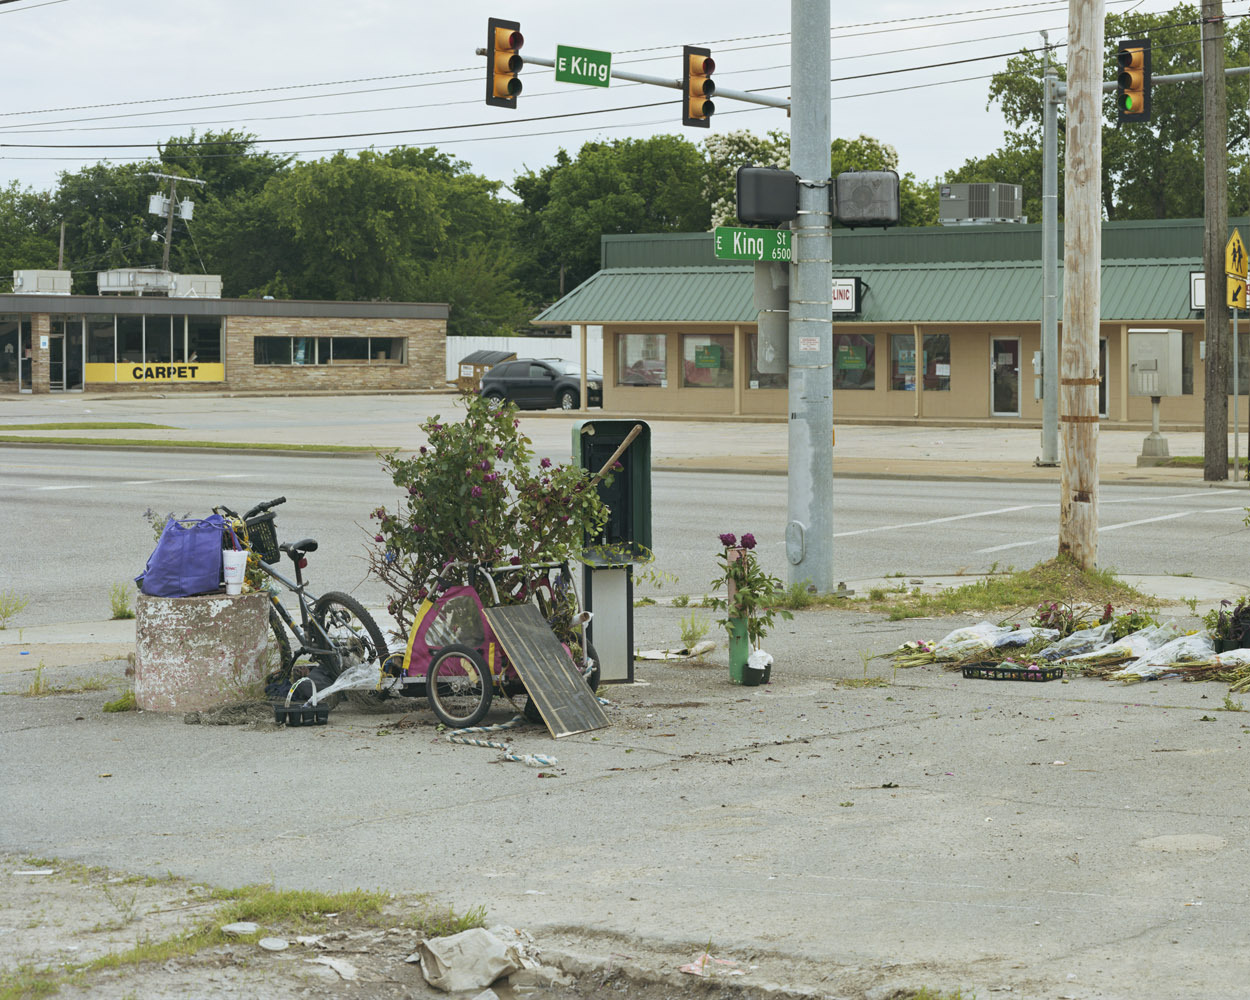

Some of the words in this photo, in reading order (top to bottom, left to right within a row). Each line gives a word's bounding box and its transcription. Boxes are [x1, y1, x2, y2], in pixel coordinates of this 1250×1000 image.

[558, 57, 567, 72] E
[571, 56, 608, 82] King
[716, 236, 723, 250] E
[733, 231, 764, 260] King
[776, 231, 786, 245] St
[772, 247, 791, 260] 6500
[832, 289, 850, 300] LINIC
[132, 366, 199, 379] CARPET
